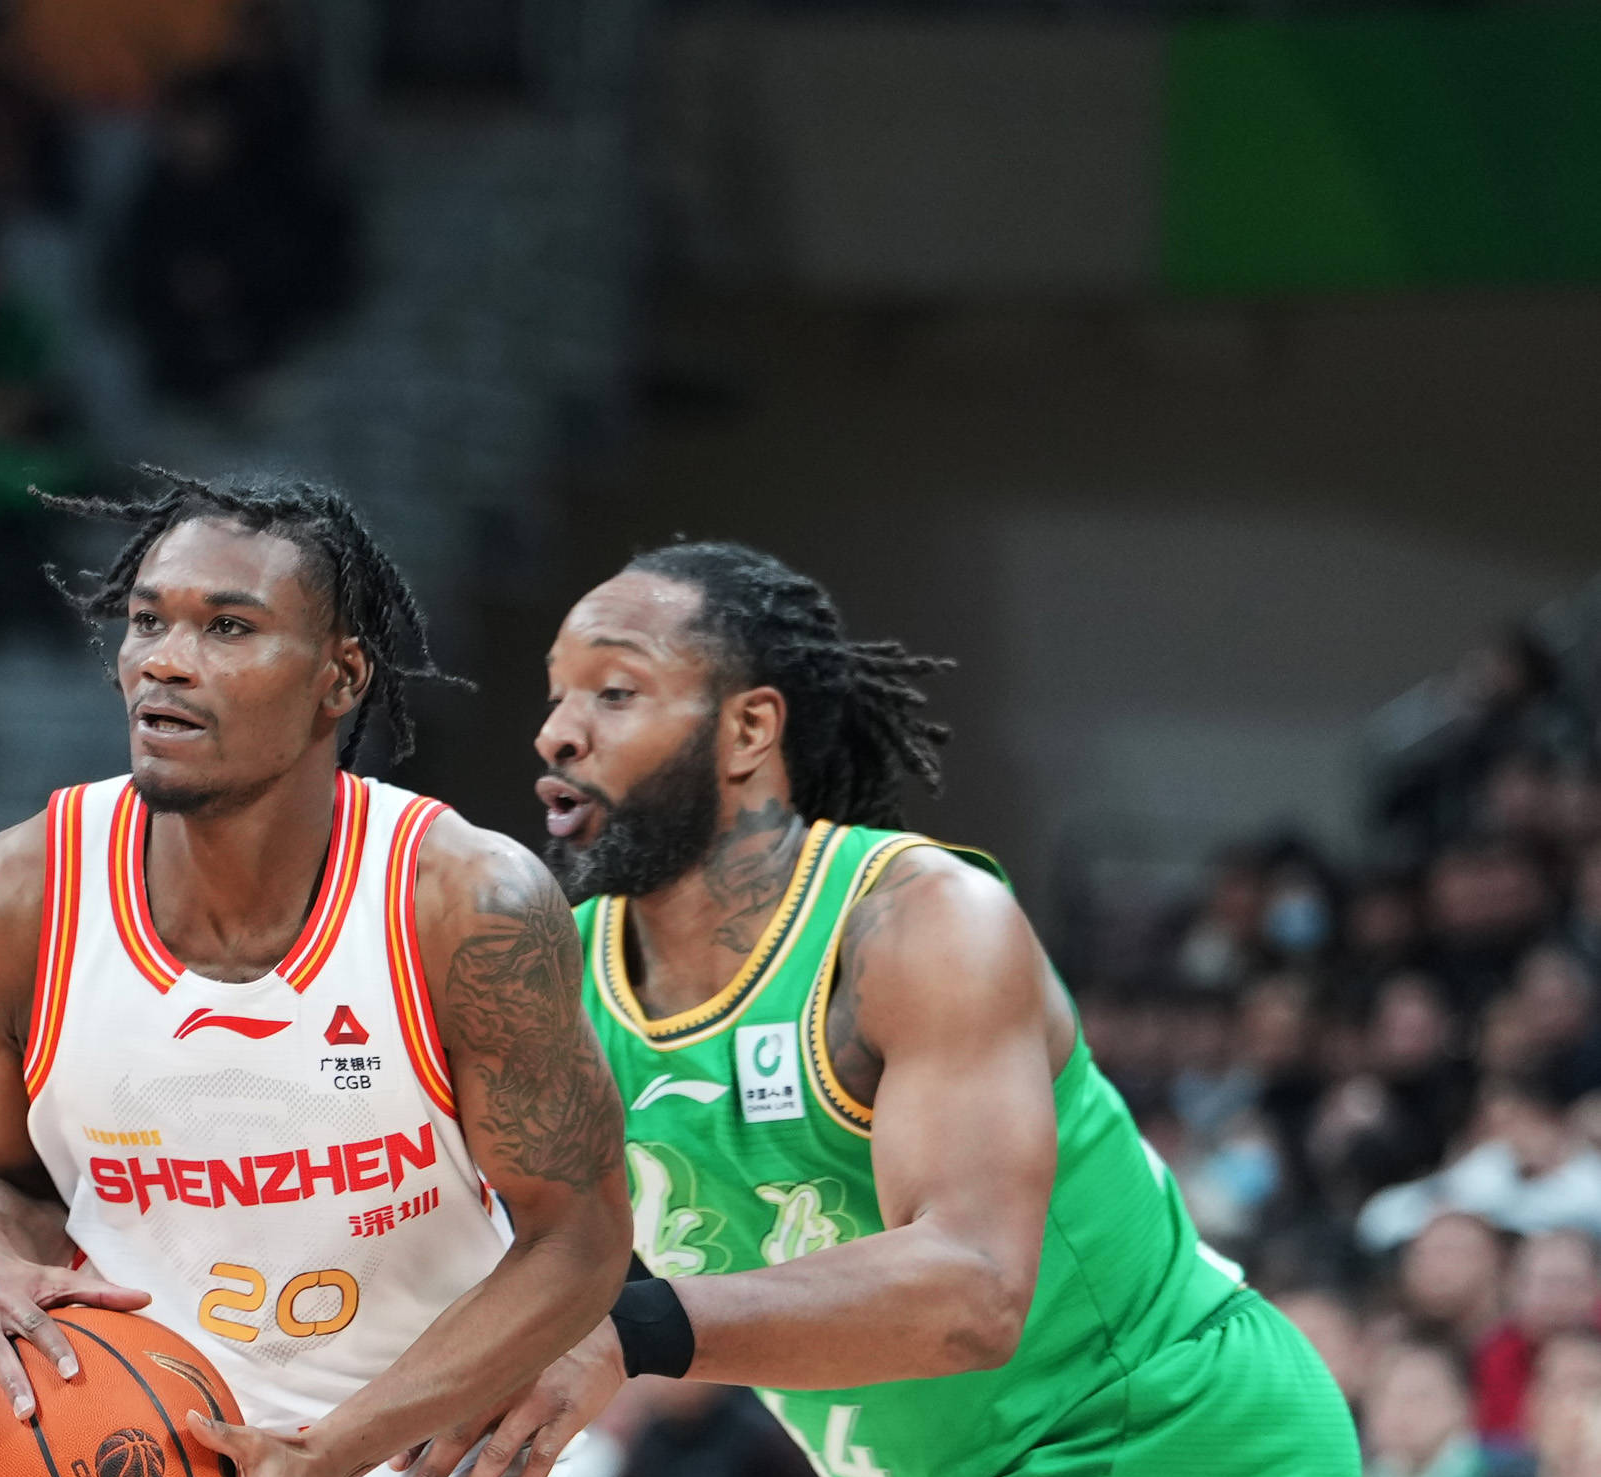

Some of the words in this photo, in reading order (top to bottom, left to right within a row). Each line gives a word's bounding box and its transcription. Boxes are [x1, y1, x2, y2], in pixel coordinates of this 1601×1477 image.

[320, 1056, 382, 1072] 广发银行
[333, 1074, 372, 1090] CGB
[89, 1121, 438, 1217] SHENZHEN
[348, 1186, 440, 1238] 深圳
[198, 1261, 360, 1343] 20
